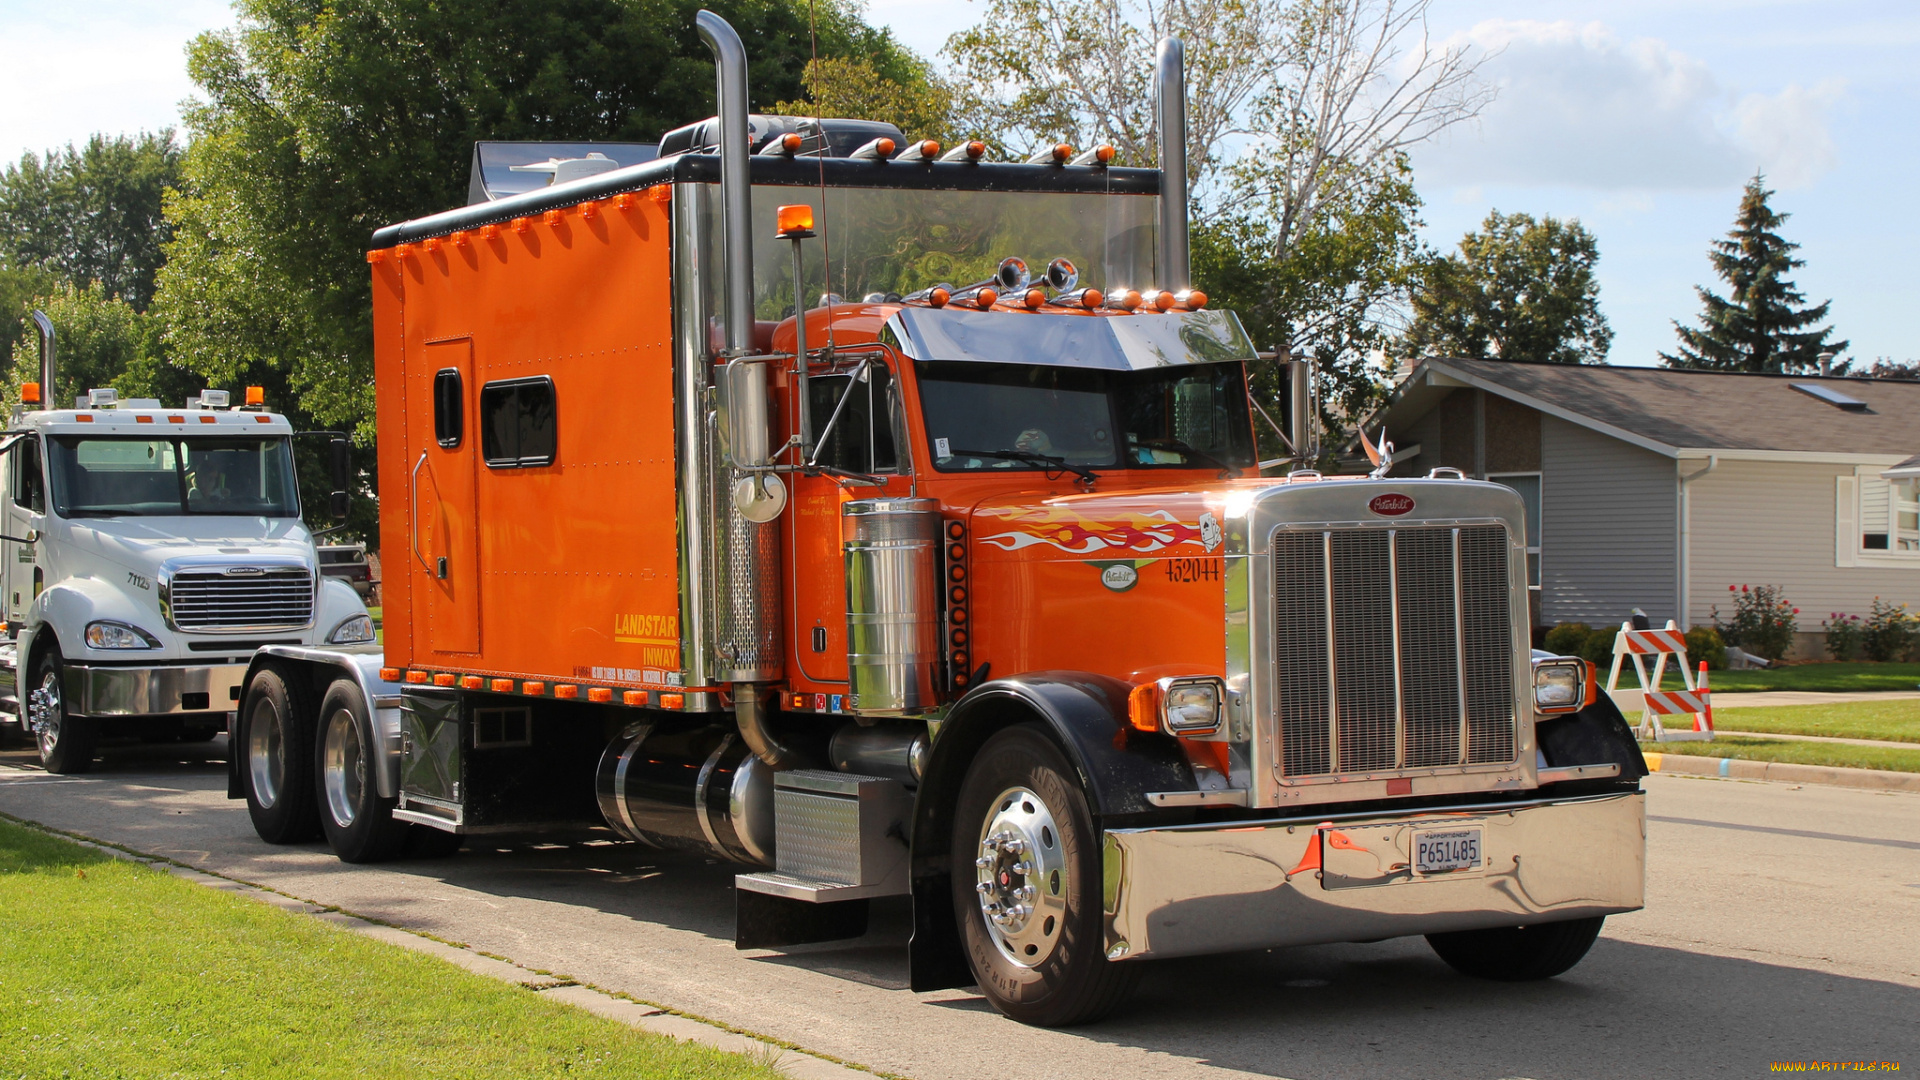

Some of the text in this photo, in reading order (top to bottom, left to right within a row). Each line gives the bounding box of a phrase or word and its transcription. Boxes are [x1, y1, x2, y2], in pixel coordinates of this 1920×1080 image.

[1374, 497, 1411, 511] Peterbilt
[127, 571, 150, 591] 71125
[615, 613, 676, 637] LANDSTAR
[643, 647, 676, 667] INWAY
[1420, 840, 1477, 863] P651485
